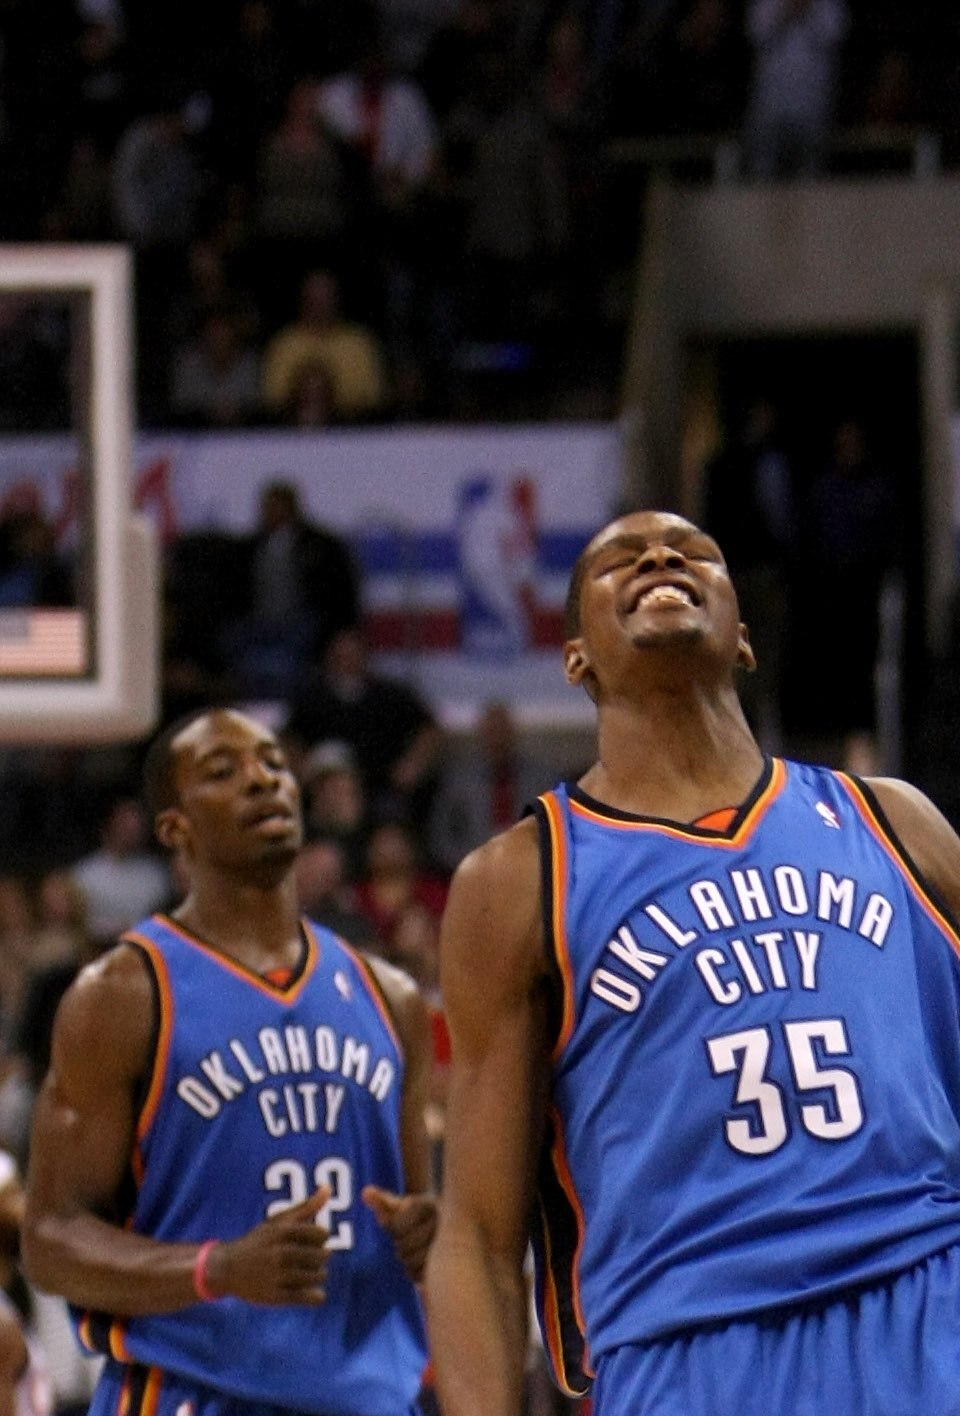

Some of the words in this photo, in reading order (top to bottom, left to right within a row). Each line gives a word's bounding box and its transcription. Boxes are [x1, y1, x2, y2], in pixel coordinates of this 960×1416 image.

[588, 864, 894, 1013] OKLAHOMA
[694, 929, 822, 1006] CITY
[176, 1024, 395, 1120] OKLAHOMA
[258, 1081, 346, 1138] CITY
[704, 1017, 866, 1157] 35
[264, 1157, 355, 1251] 22
